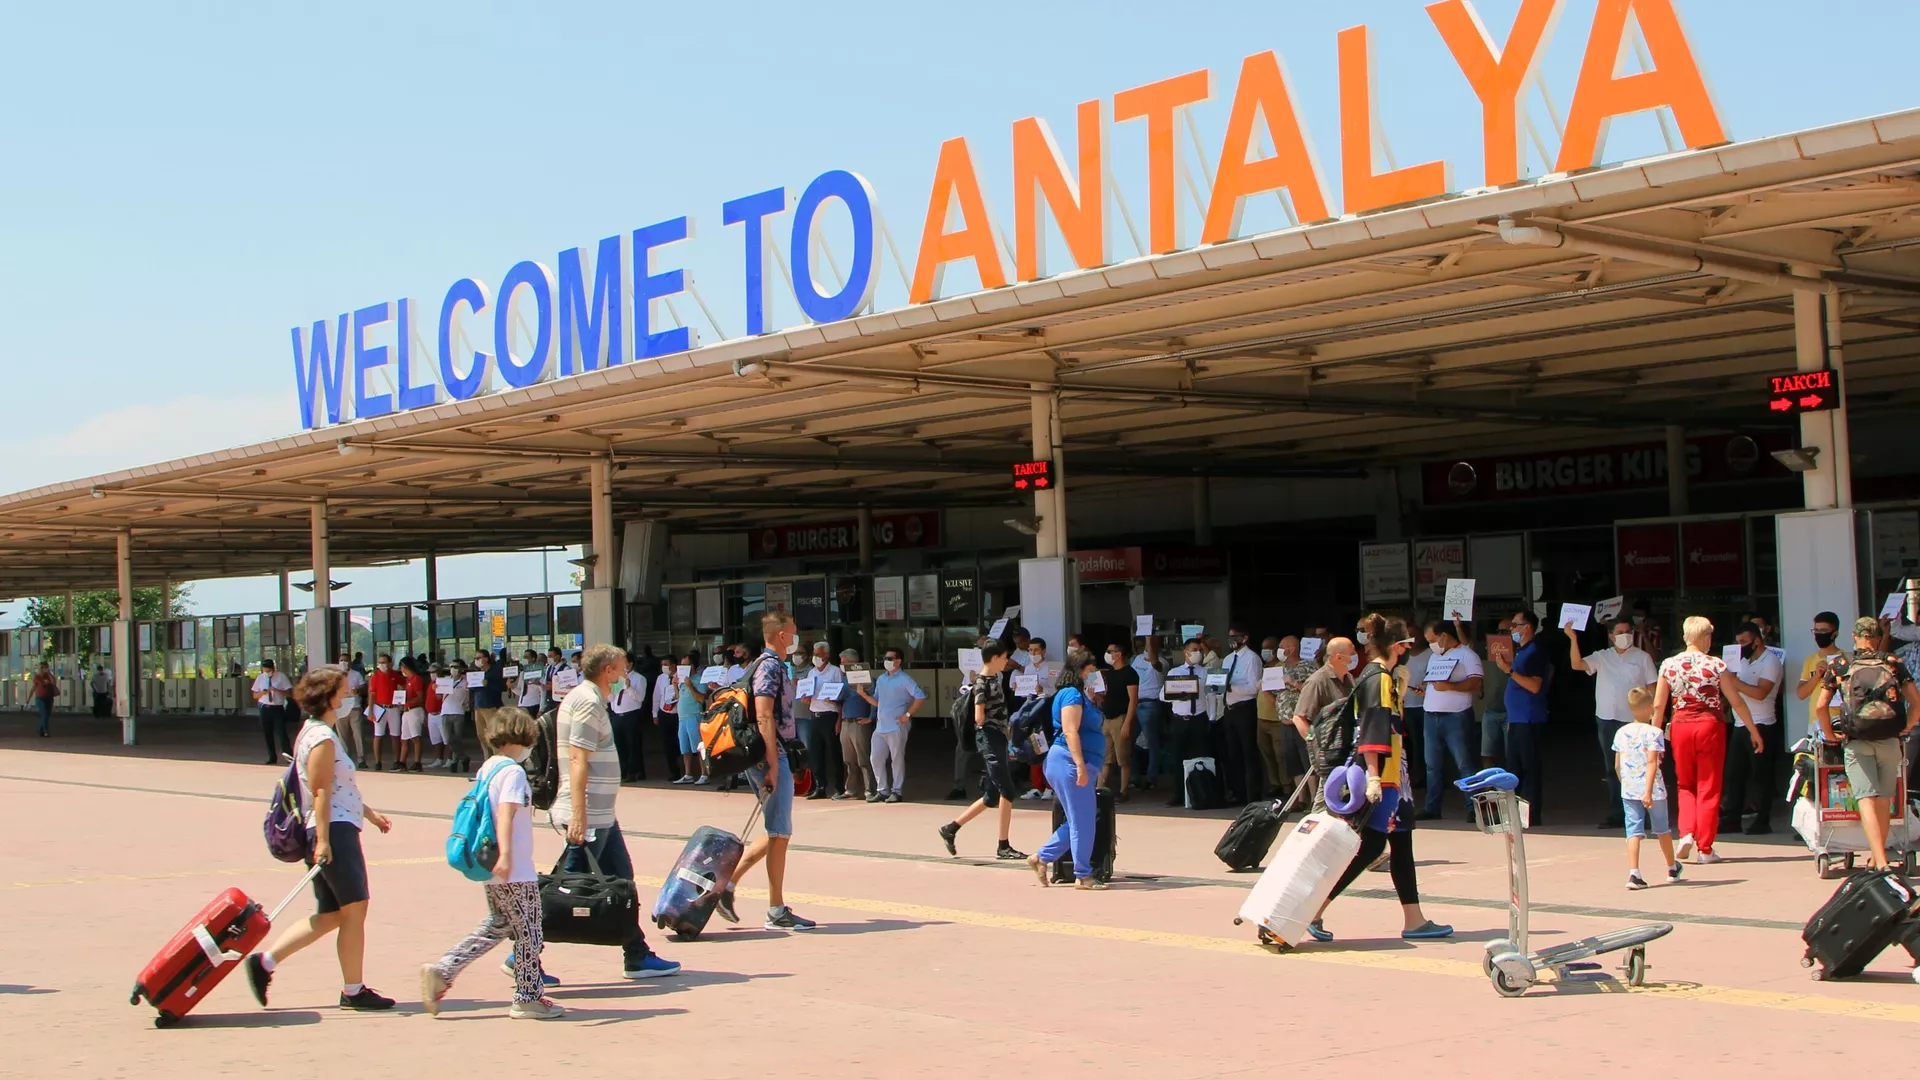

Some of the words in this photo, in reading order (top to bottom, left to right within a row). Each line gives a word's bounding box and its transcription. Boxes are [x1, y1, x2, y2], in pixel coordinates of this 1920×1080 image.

[291, 215, 694, 430] WELCOME
[722, 169, 876, 336] TO
[908, 0, 1729, 306] ANTALYA
[1771, 371, 1831, 393] ТАКСИ
[1495, 450, 1615, 492] BURGER
[786, 526, 849, 552] BURGER
[852, 521, 895, 548] KNG
[1077, 555, 1126, 573] odafone
[796, 597, 823, 605] FISCHER
